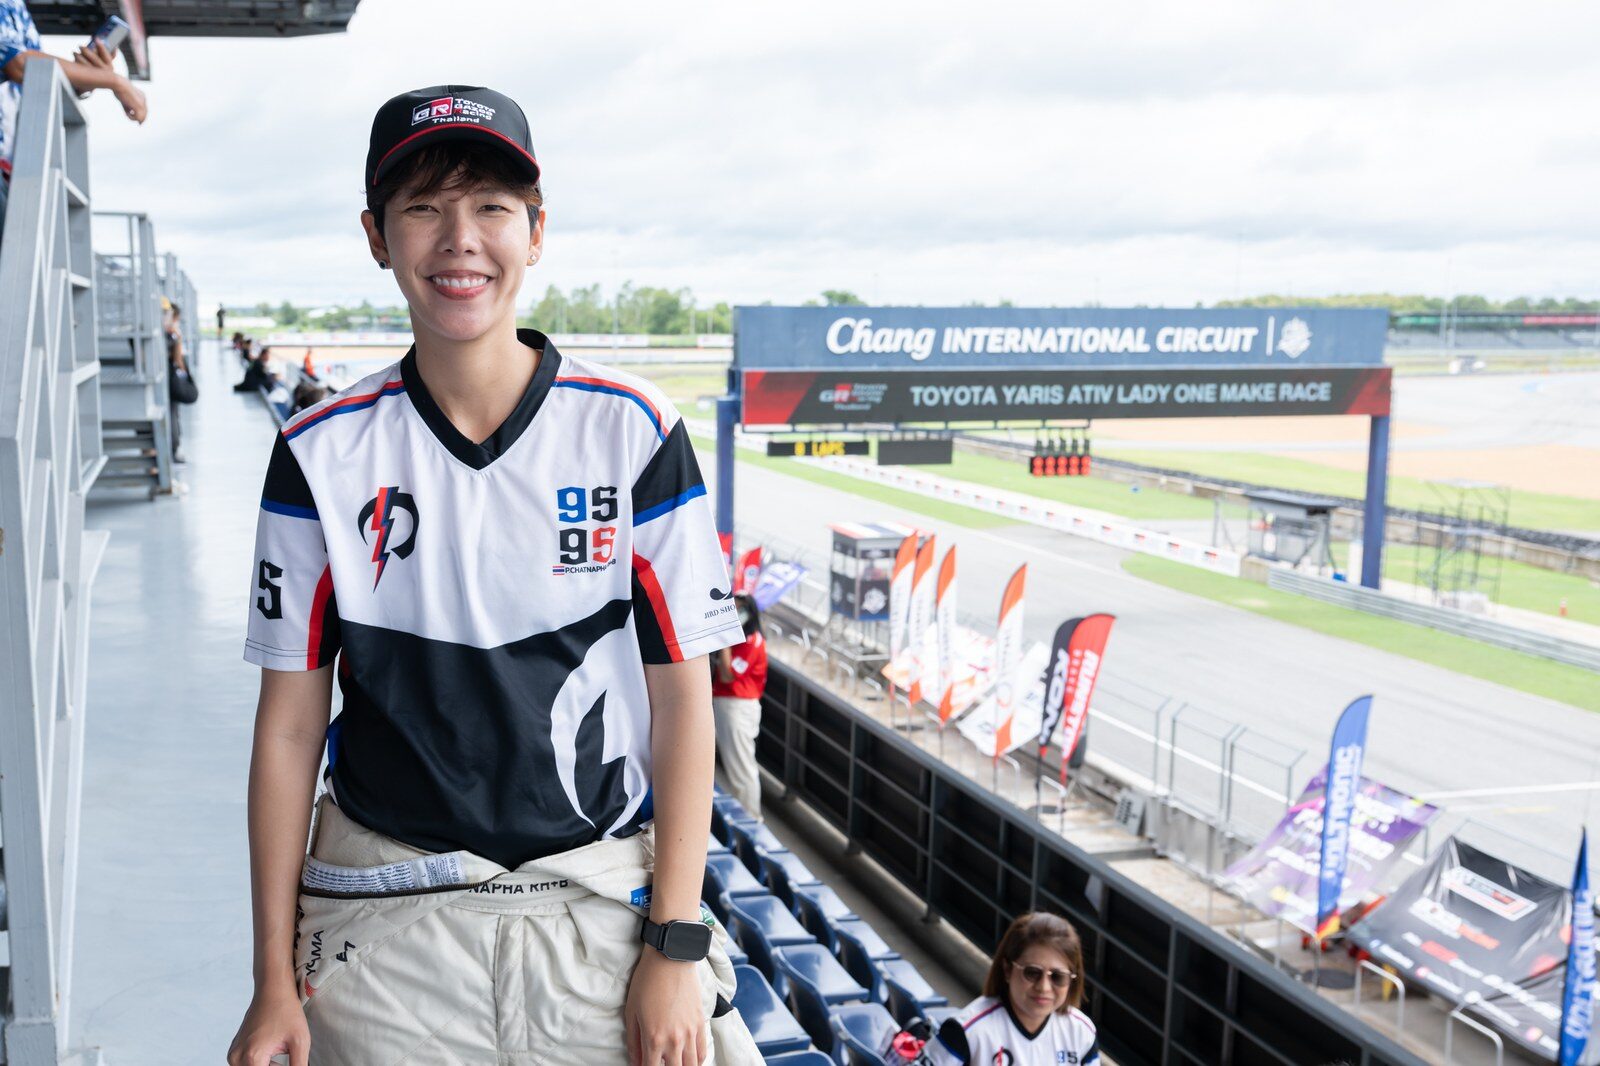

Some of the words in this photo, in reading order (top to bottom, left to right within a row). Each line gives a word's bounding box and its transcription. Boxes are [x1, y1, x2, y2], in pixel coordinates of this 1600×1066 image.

[413, 103, 450, 122] GR
[432, 115, 480, 124] Thailand
[455, 98, 496, 114] TOYOTA
[825, 317, 936, 361] Chang
[942, 326, 1150, 354] INTERNATIONAL
[1155, 326, 1259, 353] CIRCUIT
[910, 385, 997, 407] TOYOTA
[1002, 384, 1065, 406] YARIS
[1067, 383, 1115, 404] ATIV
[1117, 382, 1172, 405] LADY
[1173, 382, 1217, 404] ONE
[1219, 382, 1277, 403] MAKE
[1279, 381, 1332, 402] RACE
[557, 486, 618, 523] 95
[559, 526, 617, 565] 95
[257, 559, 283, 619] 5
